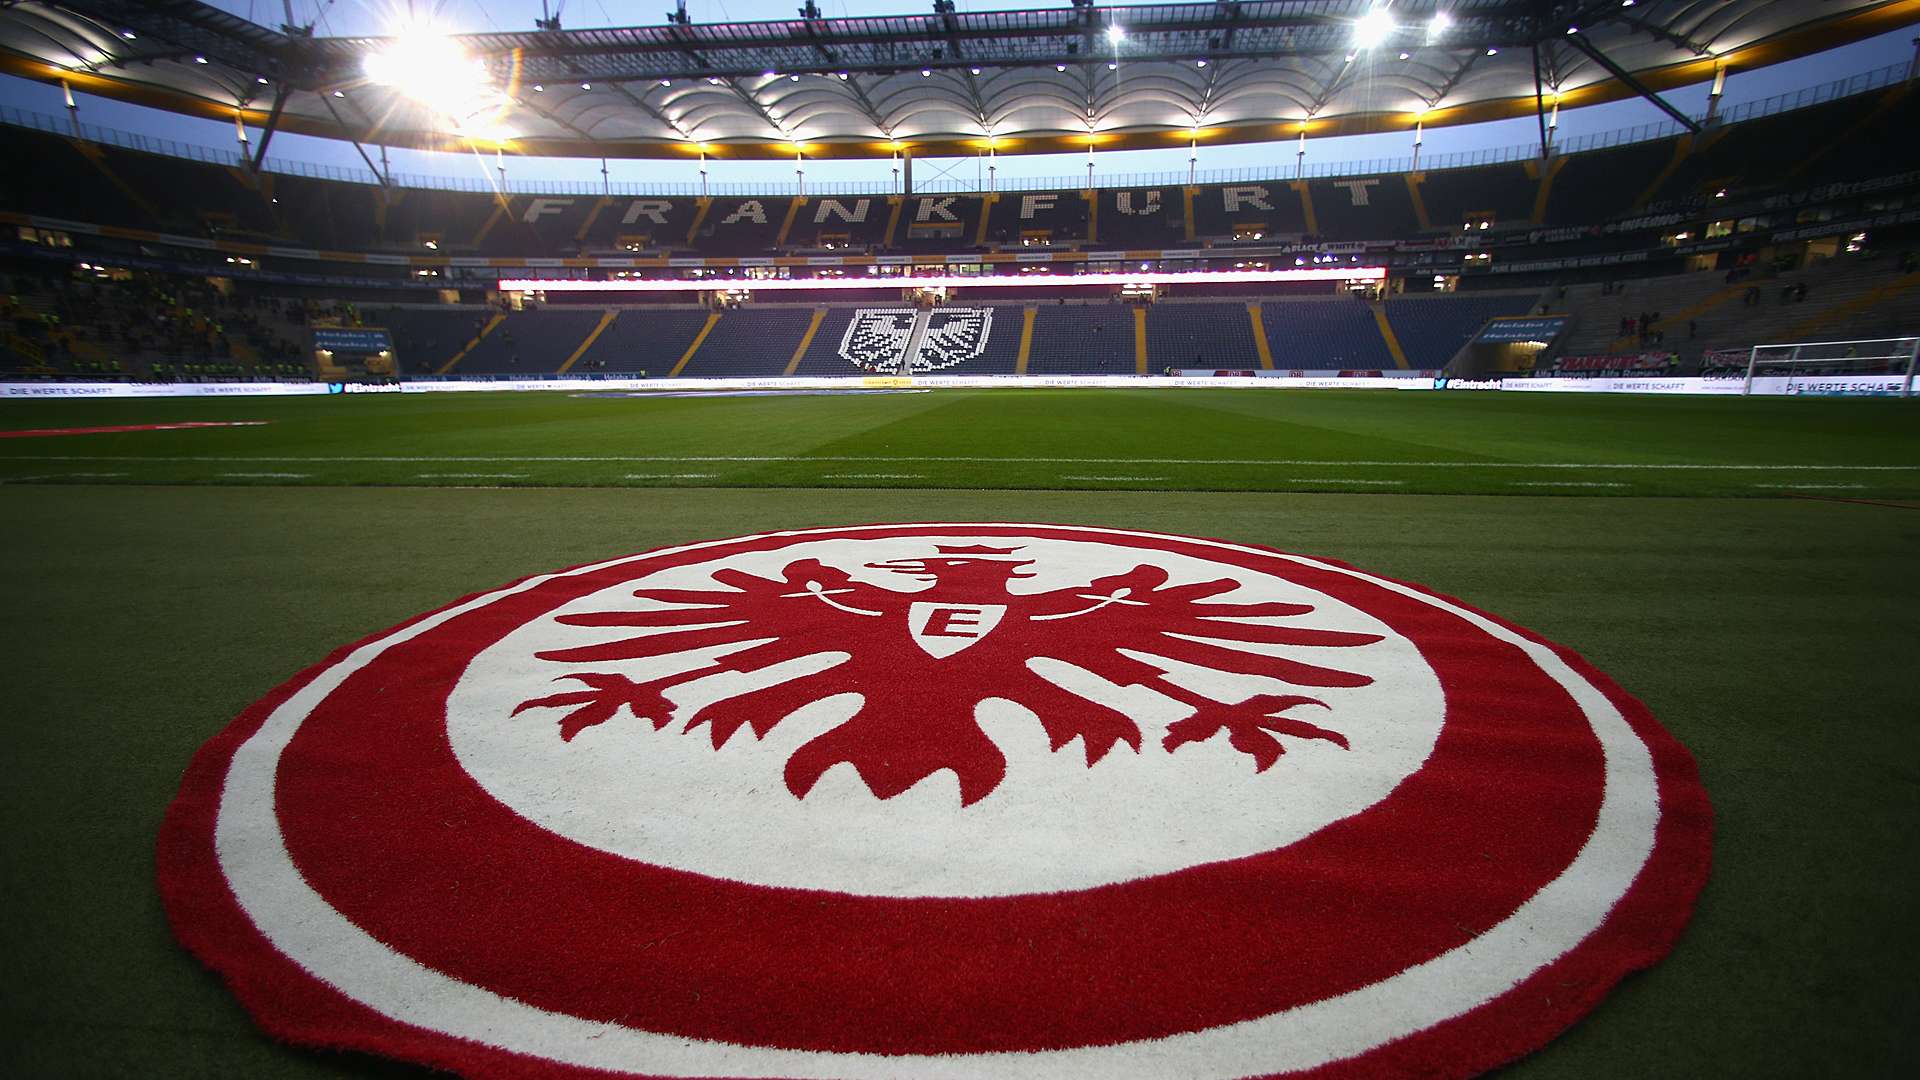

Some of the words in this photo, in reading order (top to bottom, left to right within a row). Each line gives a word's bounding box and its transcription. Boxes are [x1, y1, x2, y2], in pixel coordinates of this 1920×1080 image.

[522, 178, 1381, 225] FRANKFURT
[1446, 378, 1502, 390] #Eintracht
[1786, 383, 1805, 392] DIE
[1807, 383, 1848, 392] WERTE
[921, 608, 982, 638] E
